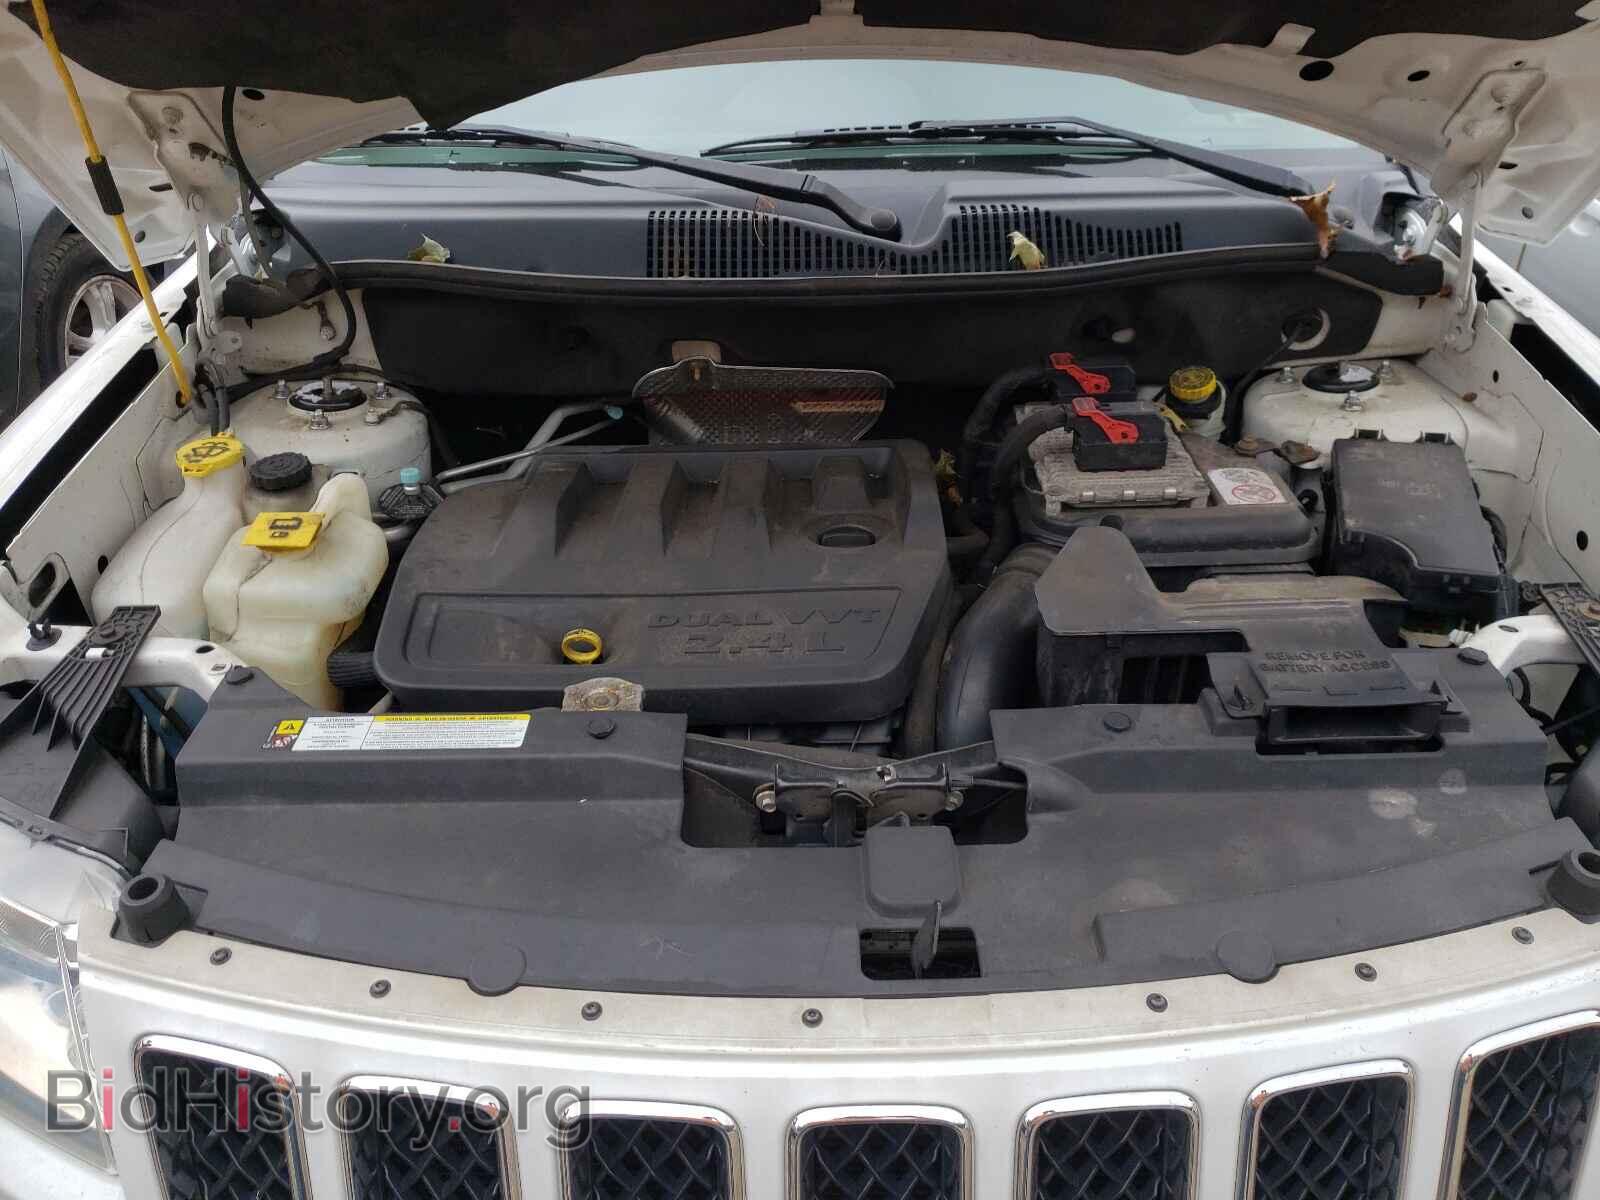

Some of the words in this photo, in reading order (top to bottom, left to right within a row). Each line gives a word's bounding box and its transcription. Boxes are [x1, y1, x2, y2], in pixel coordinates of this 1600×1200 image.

[647, 607, 774, 628] DUAL
[781, 607, 881, 625] VVT
[683, 630, 846, 655] 2.4L
[1264, 651, 1332, 661] REMOVE
[1333, 650, 1366, 660] FOR
[1261, 662, 1325, 673] BATTERY
[1329, 660, 1392, 672] ACCESS
